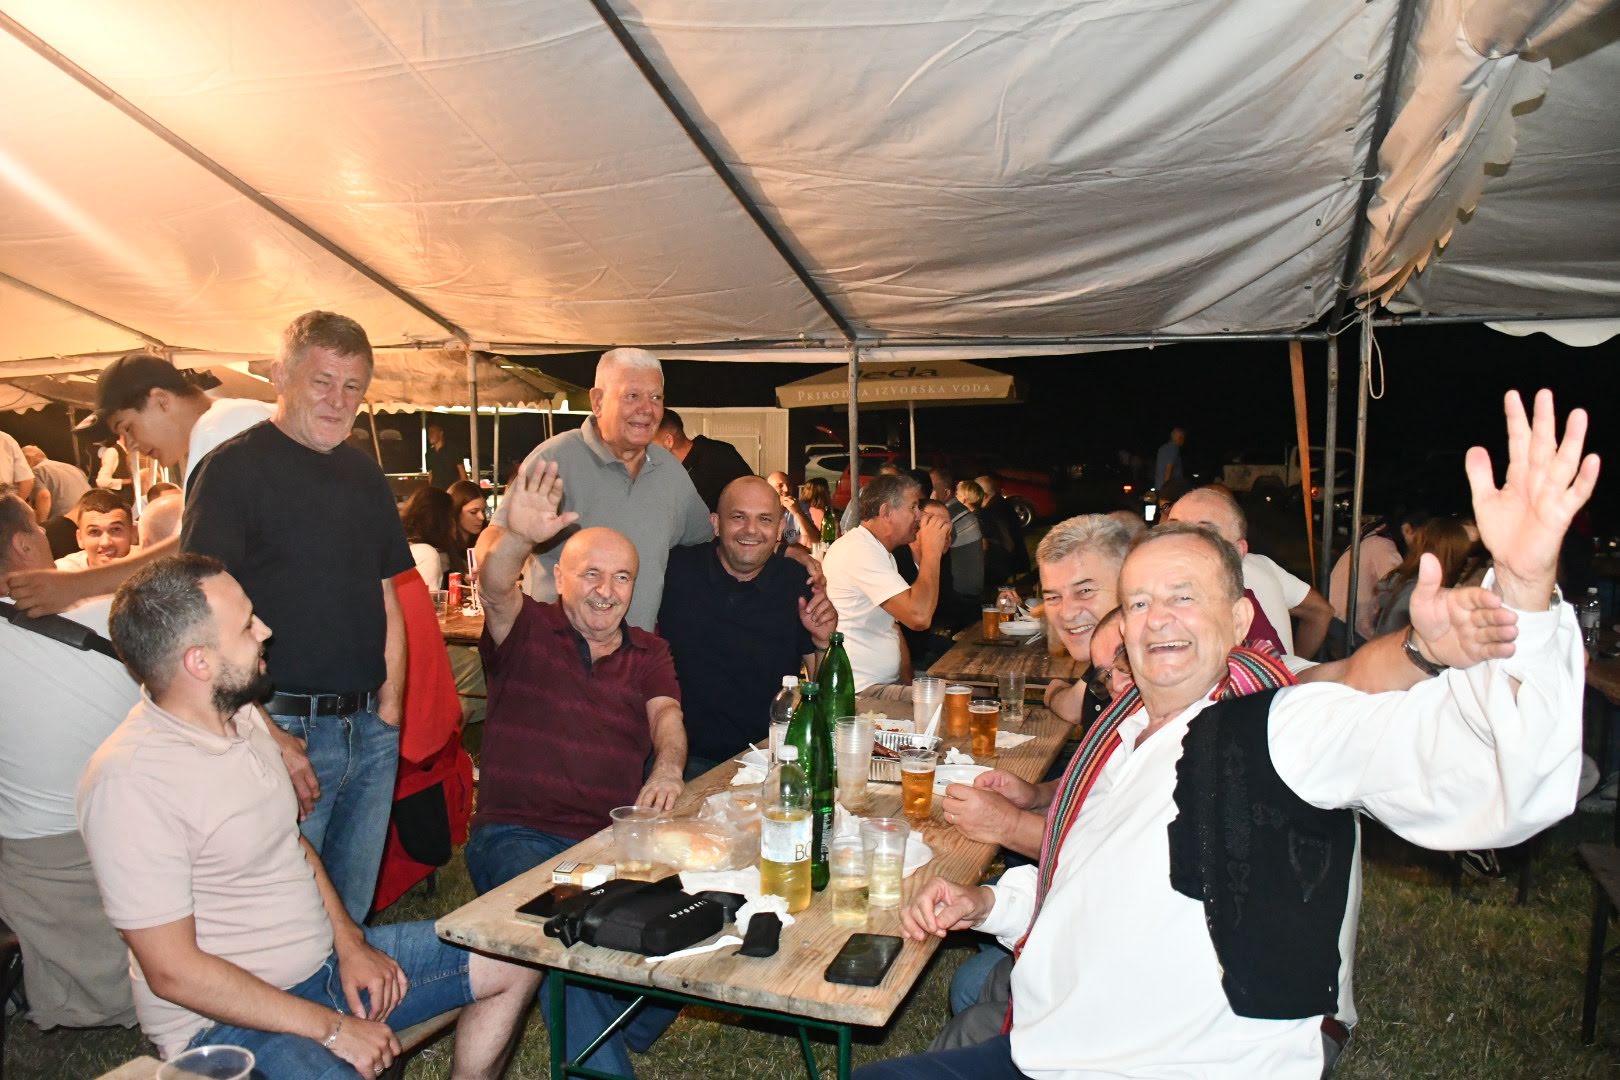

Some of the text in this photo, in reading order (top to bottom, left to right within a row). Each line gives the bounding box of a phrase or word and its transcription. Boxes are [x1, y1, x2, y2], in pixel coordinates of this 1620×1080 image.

[857, 366, 938, 380] eda
[797, 388, 869, 401] PRIRODA
[953, 383, 992, 394] VODA
